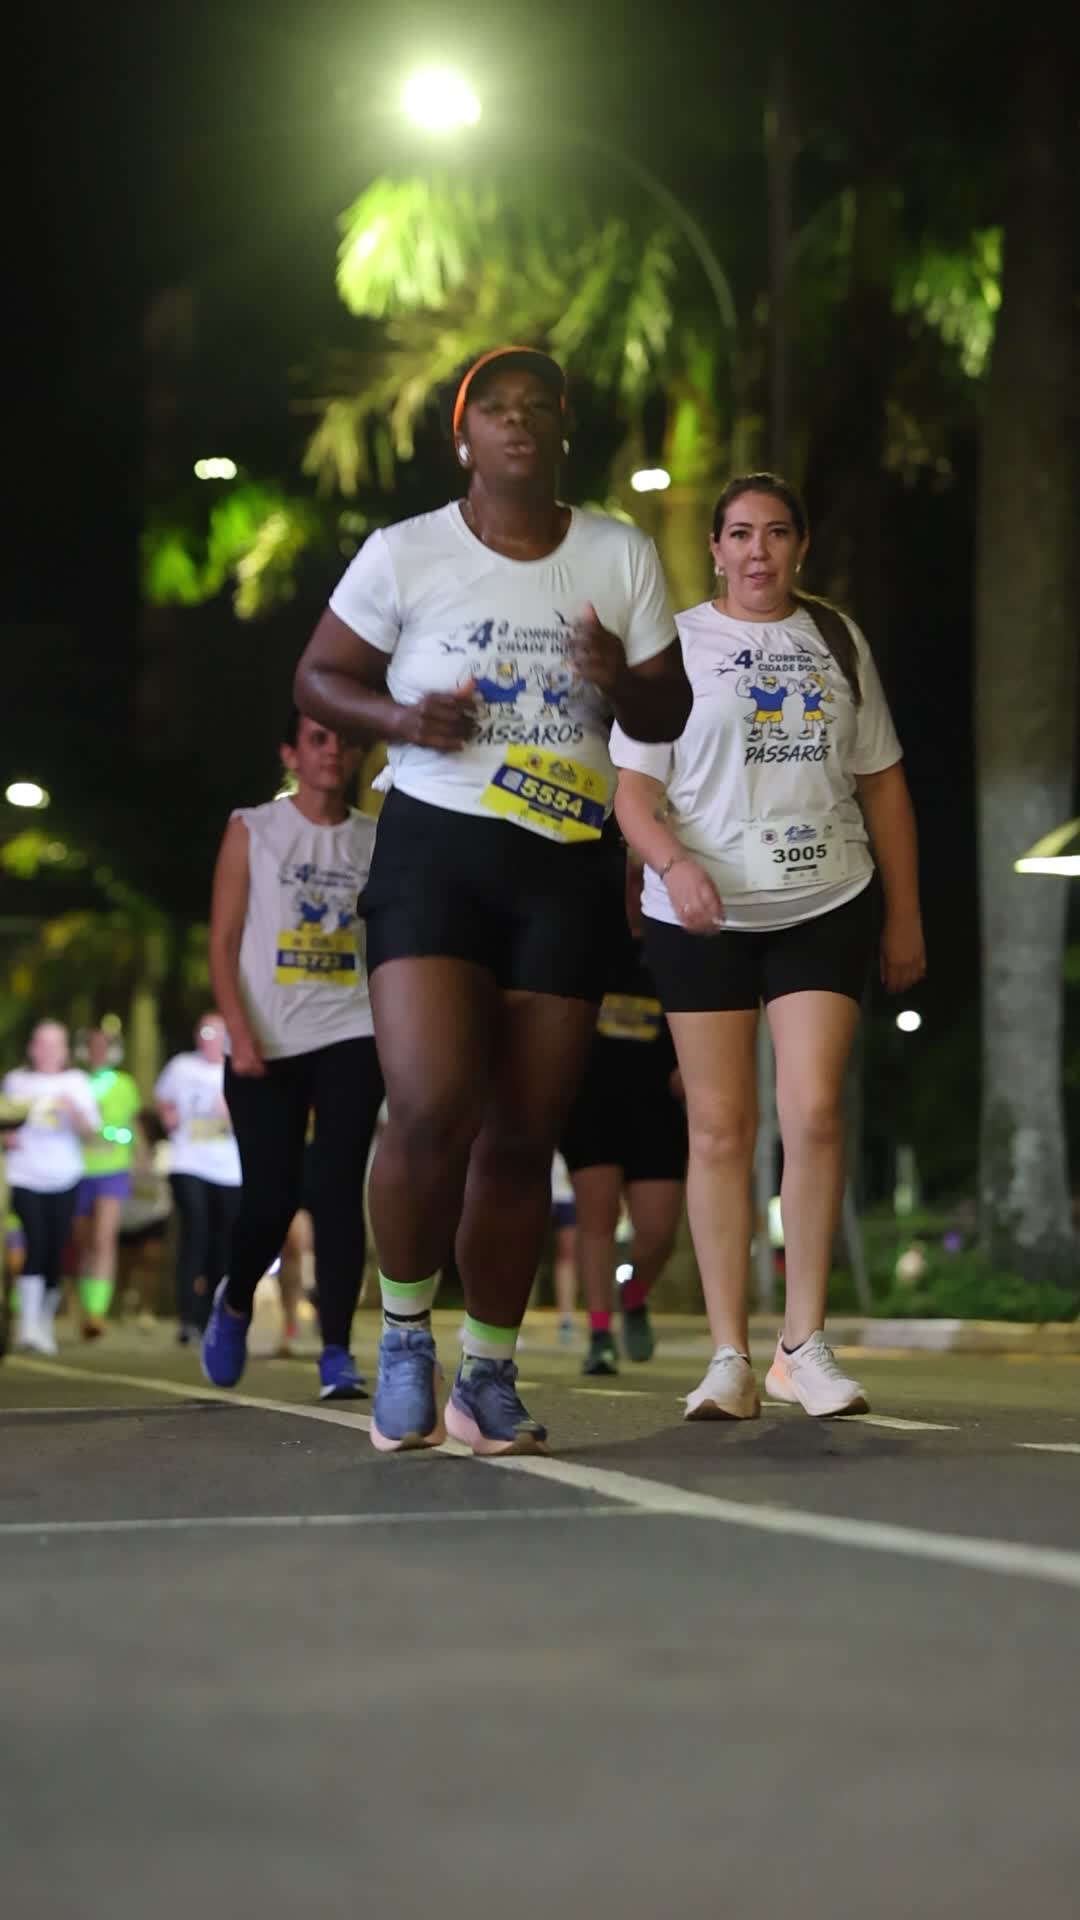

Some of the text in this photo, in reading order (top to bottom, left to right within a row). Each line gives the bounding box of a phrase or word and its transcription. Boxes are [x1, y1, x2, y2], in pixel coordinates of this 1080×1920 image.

[769, 653, 812, 663] CORRIDA
[758, 664, 818, 672] CIDADE DOS
[520, 778, 583, 817] 5554
[772, 843, 827, 863] 3005
